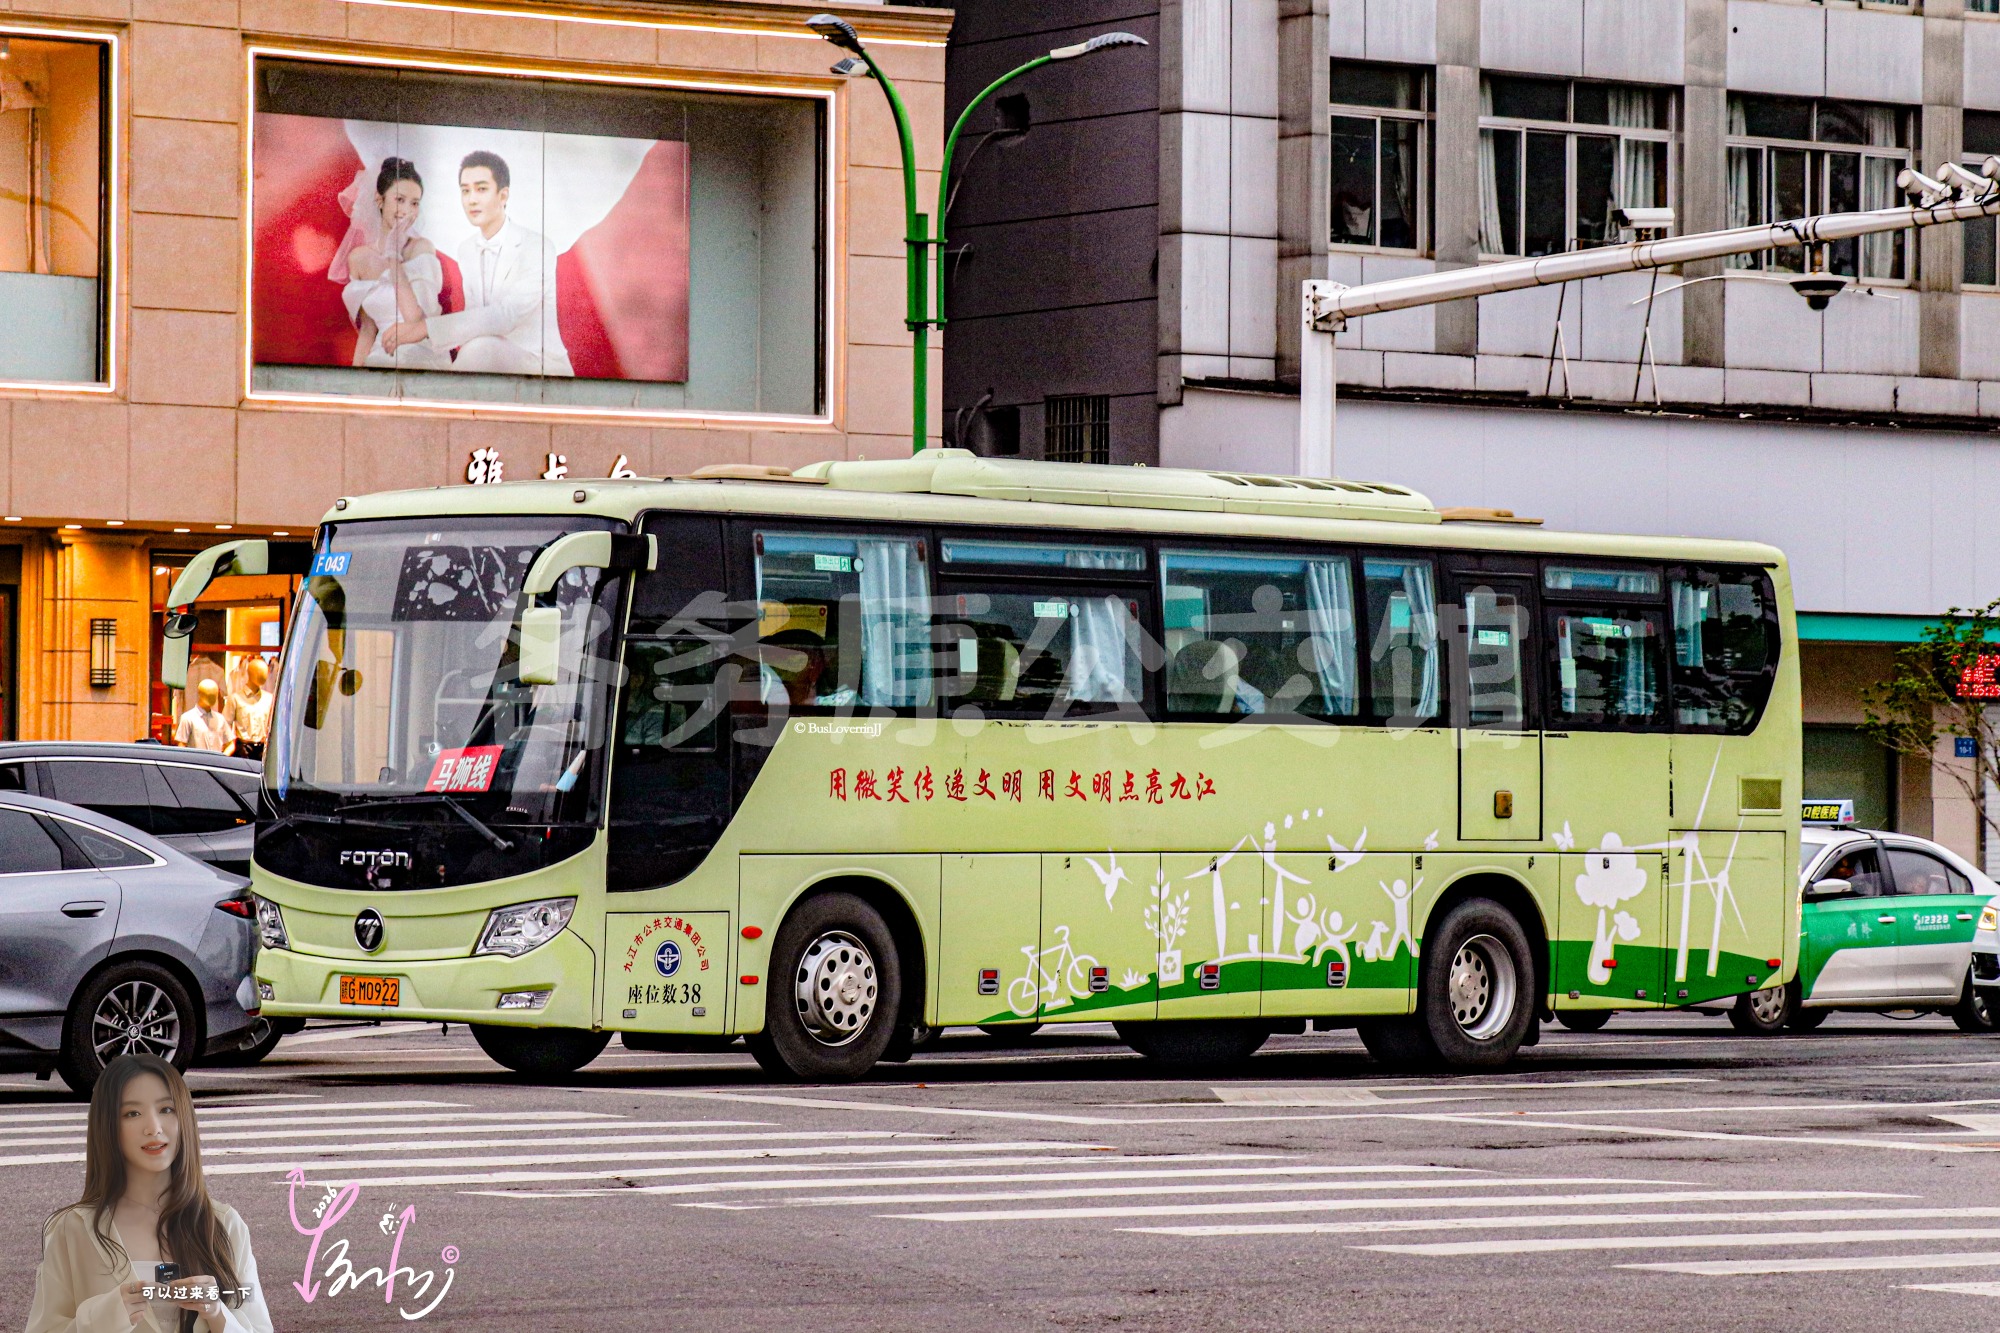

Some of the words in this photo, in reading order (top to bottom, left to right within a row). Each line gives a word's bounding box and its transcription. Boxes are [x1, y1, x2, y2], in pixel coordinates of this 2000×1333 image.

[432, 754, 493, 790] 马狮线
[623, 915, 710, 973] 九江市公共交通集团公司
